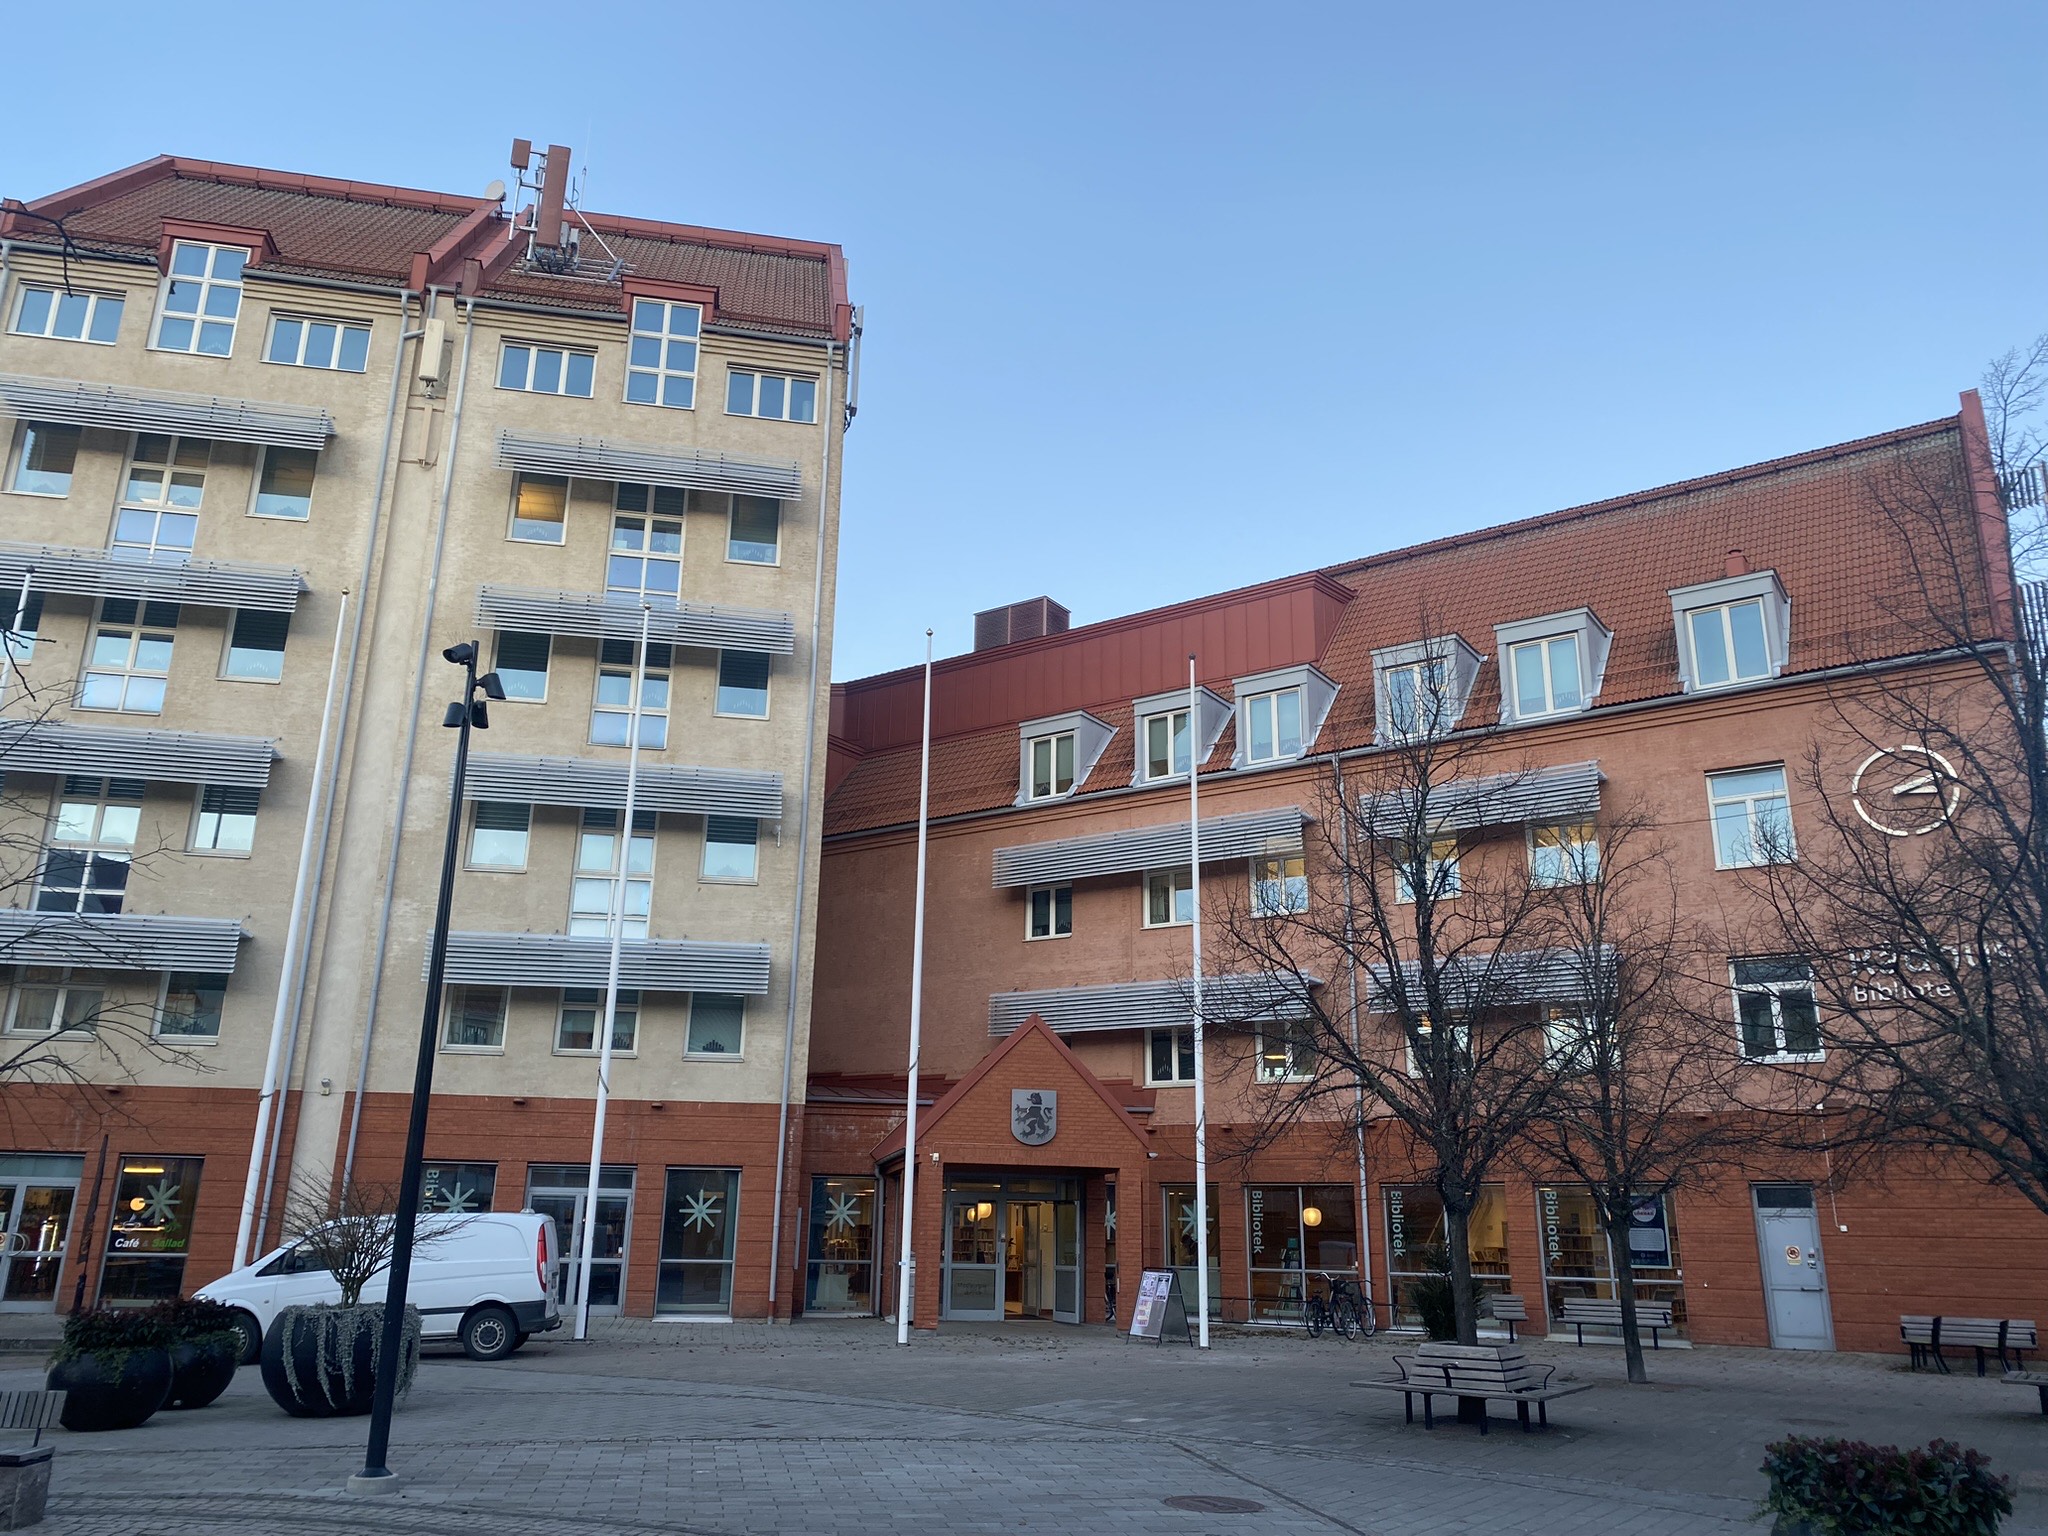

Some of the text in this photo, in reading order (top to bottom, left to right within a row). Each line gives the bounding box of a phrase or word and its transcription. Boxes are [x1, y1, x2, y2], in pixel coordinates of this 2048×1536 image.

[1853, 980, 1958, 1003] Bibliote
[422, 1169, 440, 1213] Biblio
[114, 1238, 139, 1248] Café
[151, 1238, 186, 1249] Sallad
[1251, 1190, 1264, 1254] Bibliotek
[1390, 1190, 1406, 1257] Bibliotek
[1544, 1190, 1562, 1261] Bibliotek
